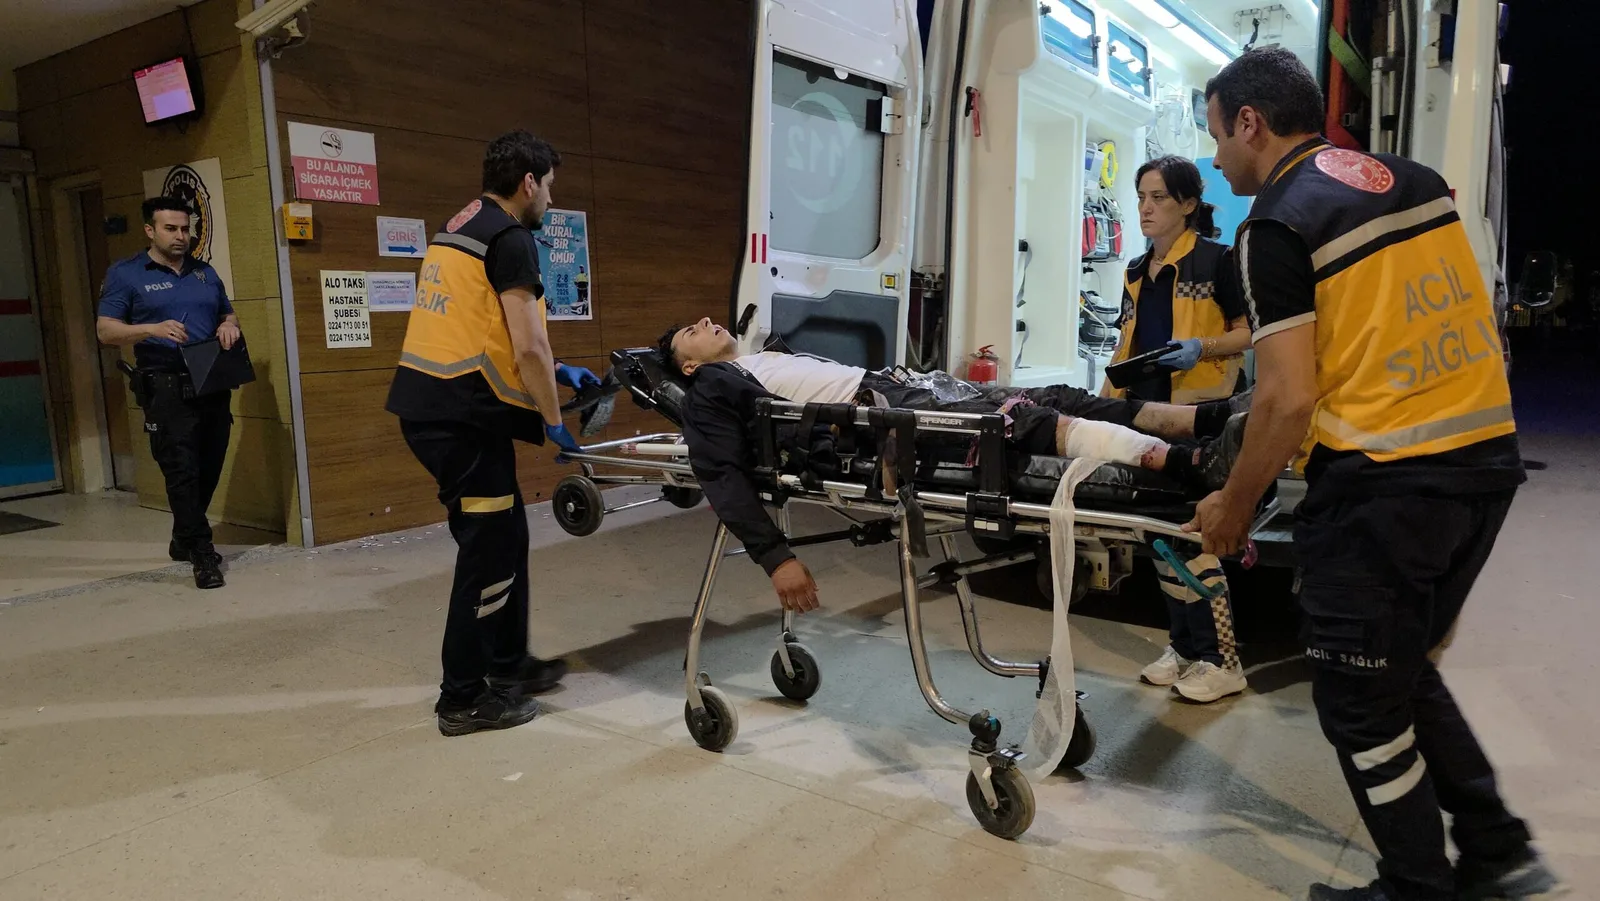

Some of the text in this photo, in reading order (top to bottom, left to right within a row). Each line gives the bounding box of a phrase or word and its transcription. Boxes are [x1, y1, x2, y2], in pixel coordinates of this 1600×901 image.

[306, 159, 364, 175] BU ALANDA
[300, 171, 372, 190] SİGARA İÇMEK
[313, 188, 362, 202] YASAKTIR
[544, 226, 574, 238] KURAL
[549, 249, 575, 263] ÖMÜR
[325, 277, 340, 288] ALO
[1404, 257, 1473, 323] ACİL
[329, 296, 364, 304] HASTANE
[328, 322, 342, 330] 0224
[343, 321, 353, 329] 713
[362, 321, 368, 329] 51
[329, 334, 342, 342] 0224
[920, 416, 963, 426] SPENCER
